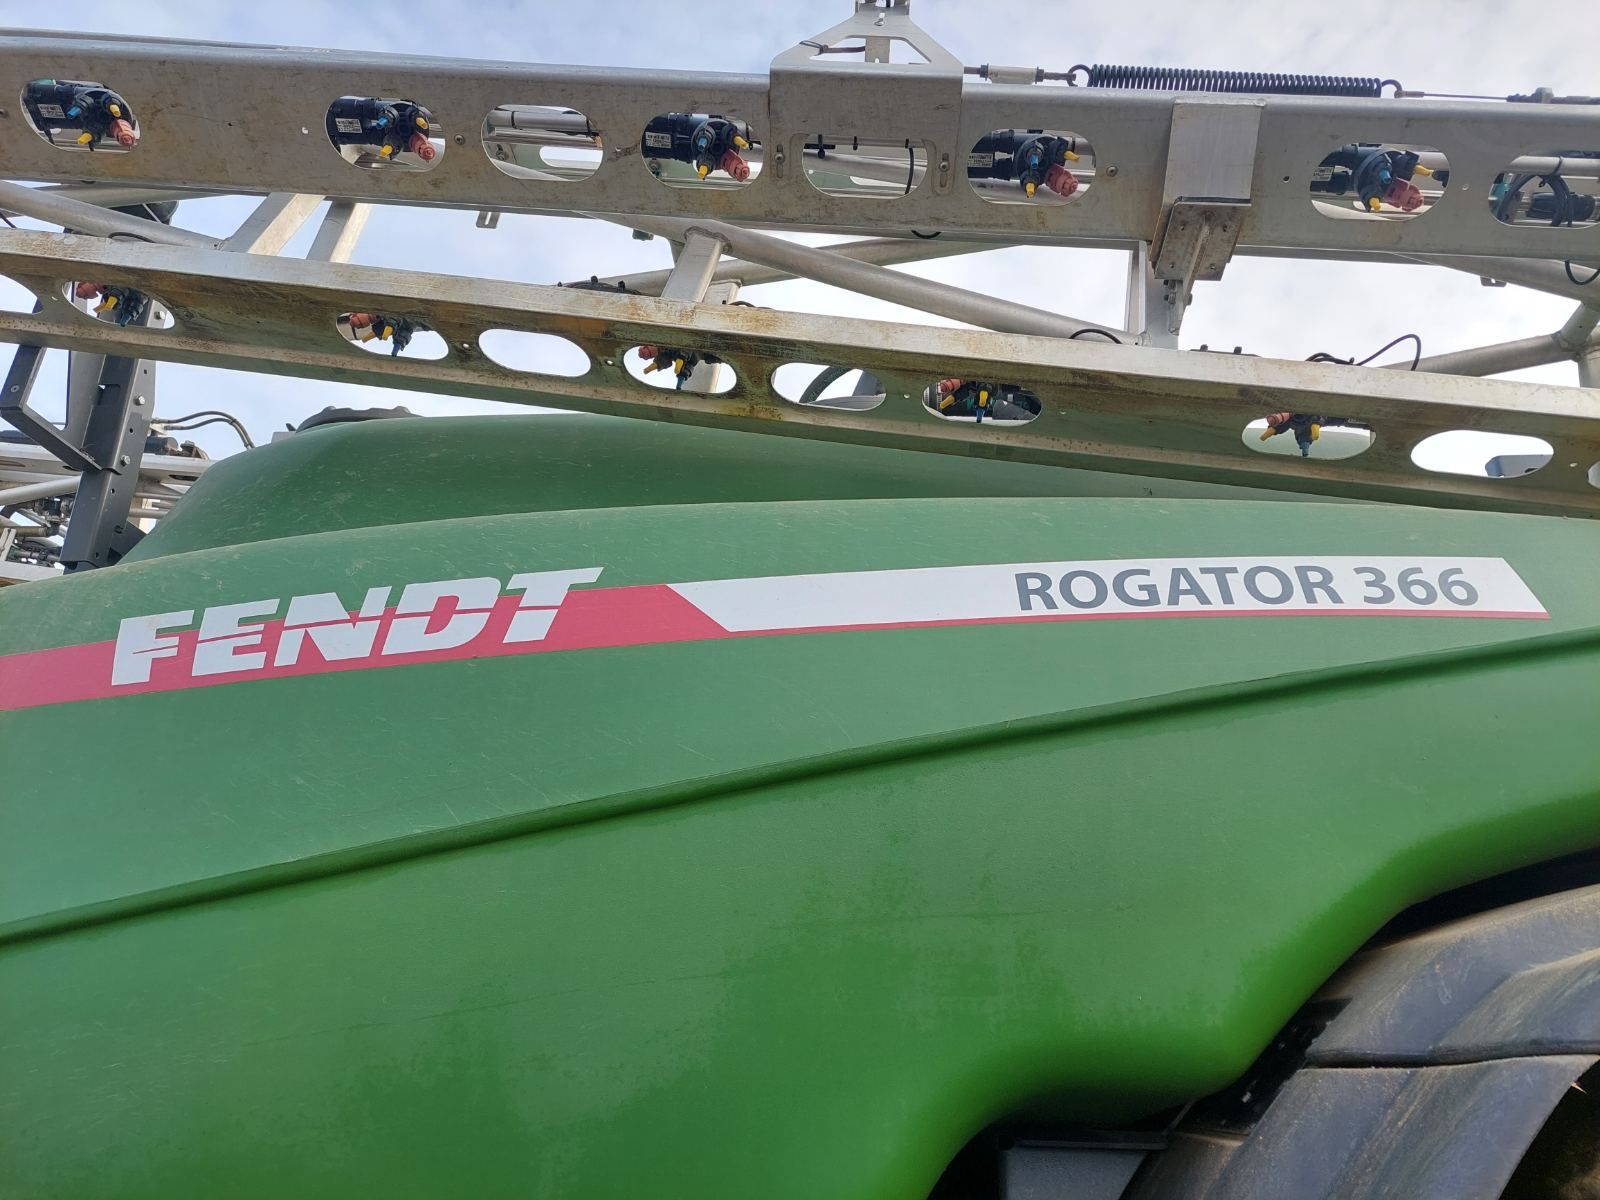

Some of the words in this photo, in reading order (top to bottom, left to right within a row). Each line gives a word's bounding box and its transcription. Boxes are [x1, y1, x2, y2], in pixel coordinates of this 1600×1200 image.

[111, 567, 603, 686] FENDT
[1015, 565, 1344, 611] ROGATOR
[1353, 566, 1478, 607] 366
